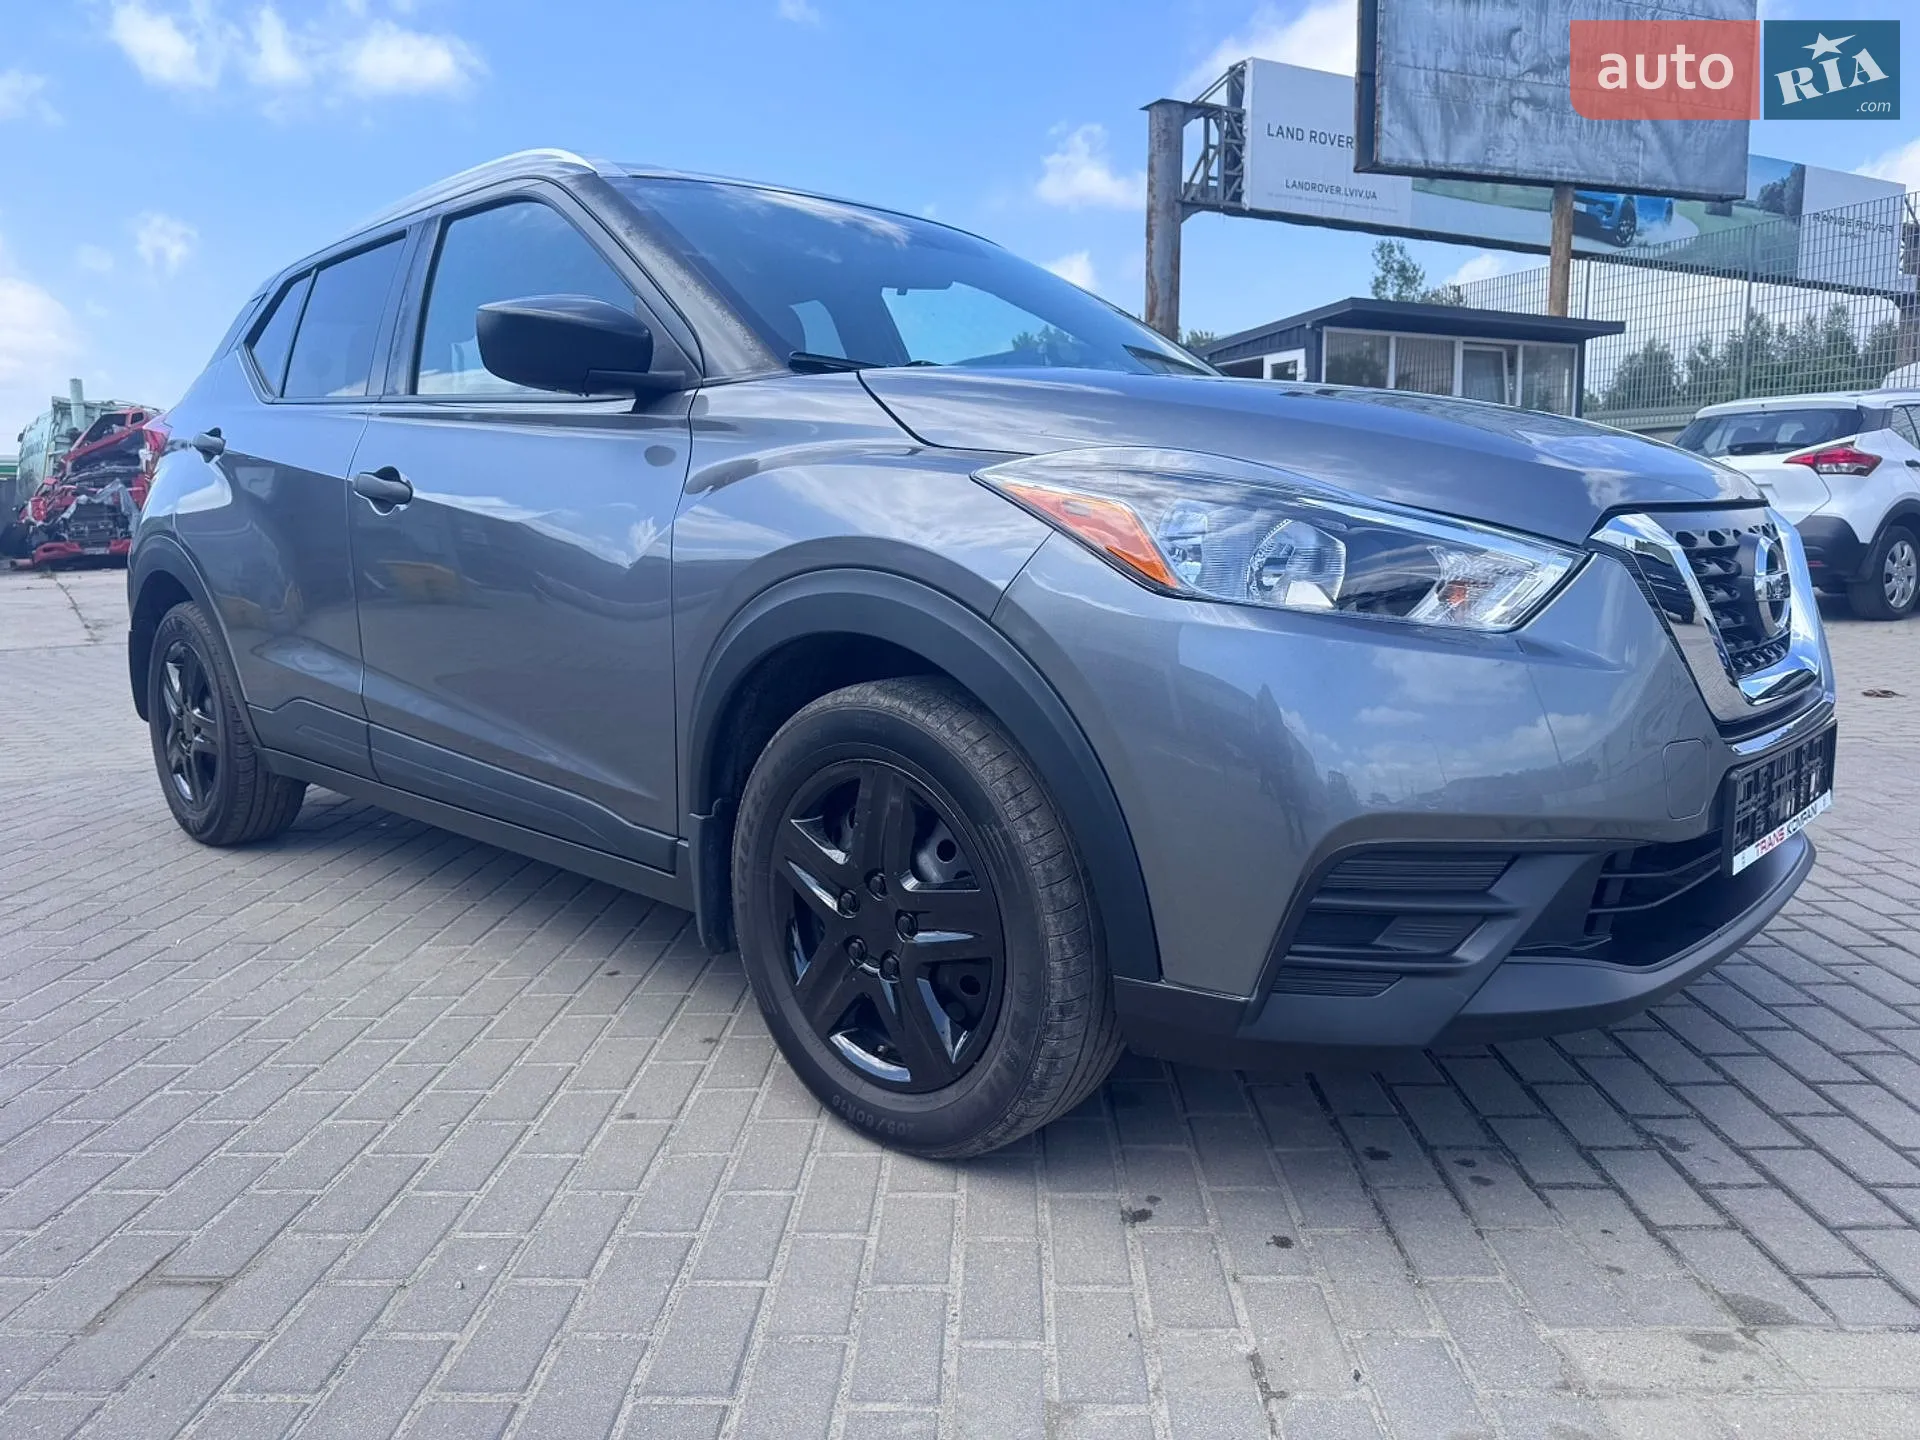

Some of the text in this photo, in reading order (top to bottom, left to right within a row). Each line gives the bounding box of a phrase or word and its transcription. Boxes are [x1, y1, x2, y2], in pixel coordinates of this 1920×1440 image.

[1266, 122, 1354, 149] LAND ROVER
[1285, 179, 1377, 200] LANDROVER.LVIV.UA
[1755, 826, 1785, 857] TRANS
